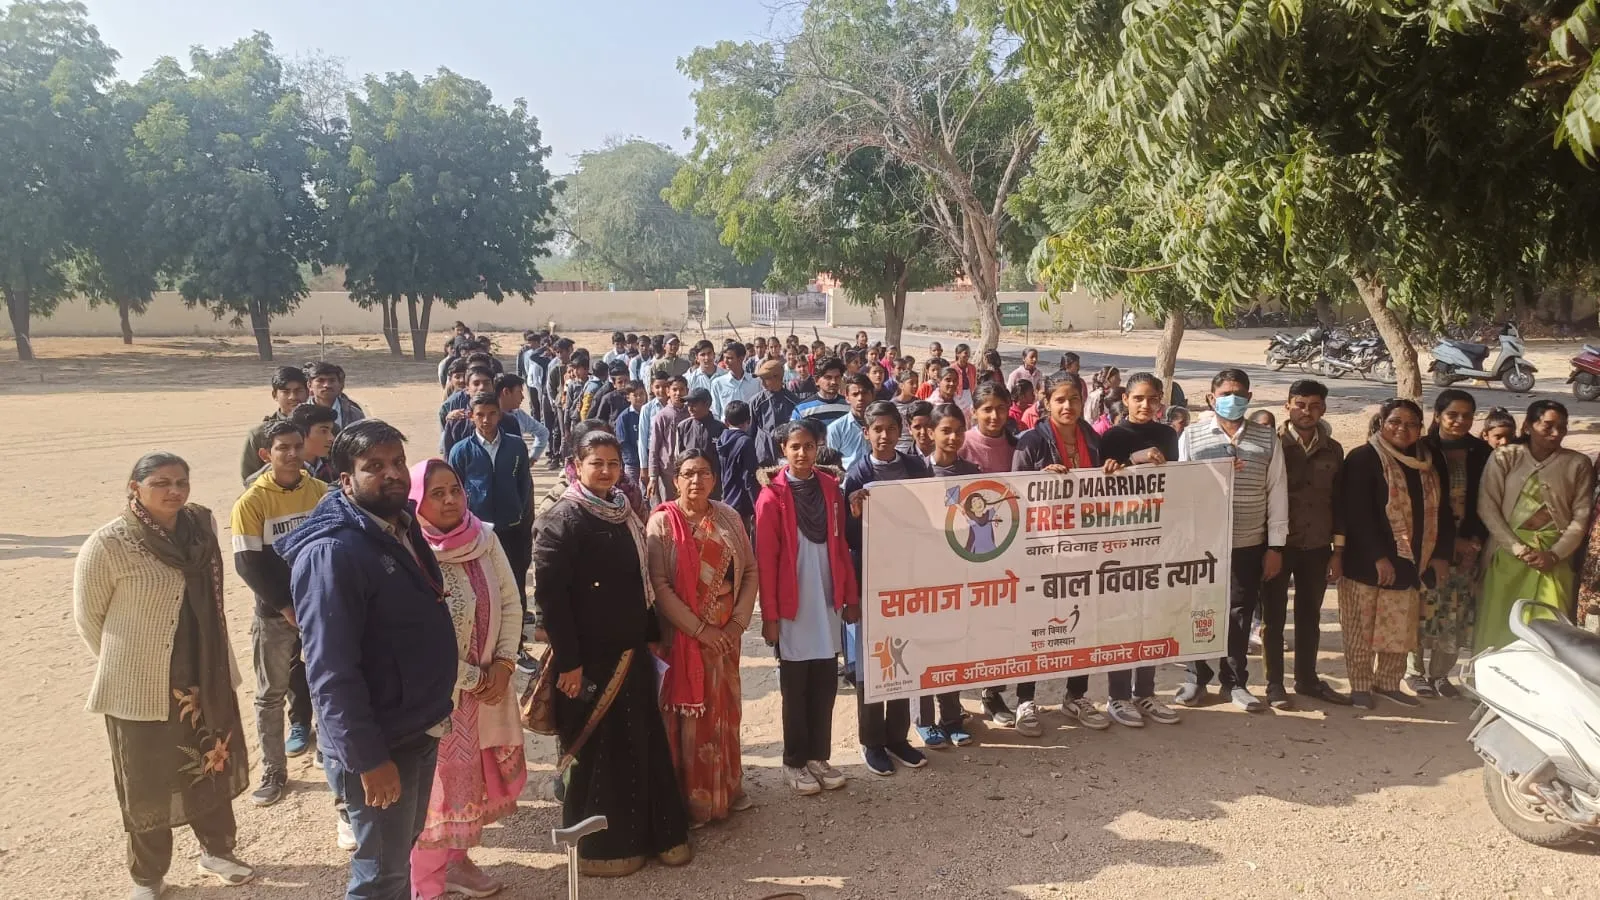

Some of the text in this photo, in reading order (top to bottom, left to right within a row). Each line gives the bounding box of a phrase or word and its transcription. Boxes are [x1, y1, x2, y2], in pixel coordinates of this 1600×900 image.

[1028, 473, 1166, 501] CHILD MARRIAGE
[1026, 498, 1164, 532] FREE BHARAT
[1026, 535, 1161, 556] बाल विवाह मुक्त भारत
[878, 584, 963, 617] समाज
[967, 569, 1020, 606] जागे
[1041, 570, 1092, 599] बाल
[1096, 561, 1161, 594] विवाह
[1165, 551, 1217, 587] त्यागे
[1031, 625, 1067, 636] बाल विवाह
[931, 668, 957, 684] बाल
[963, 658, 1031, 681] अधिकारिता
[1036, 654, 1073, 671] विभाग
[1090, 647, 1133, 665] बीकानेर
[1138, 639, 1171, 660] (राज)
